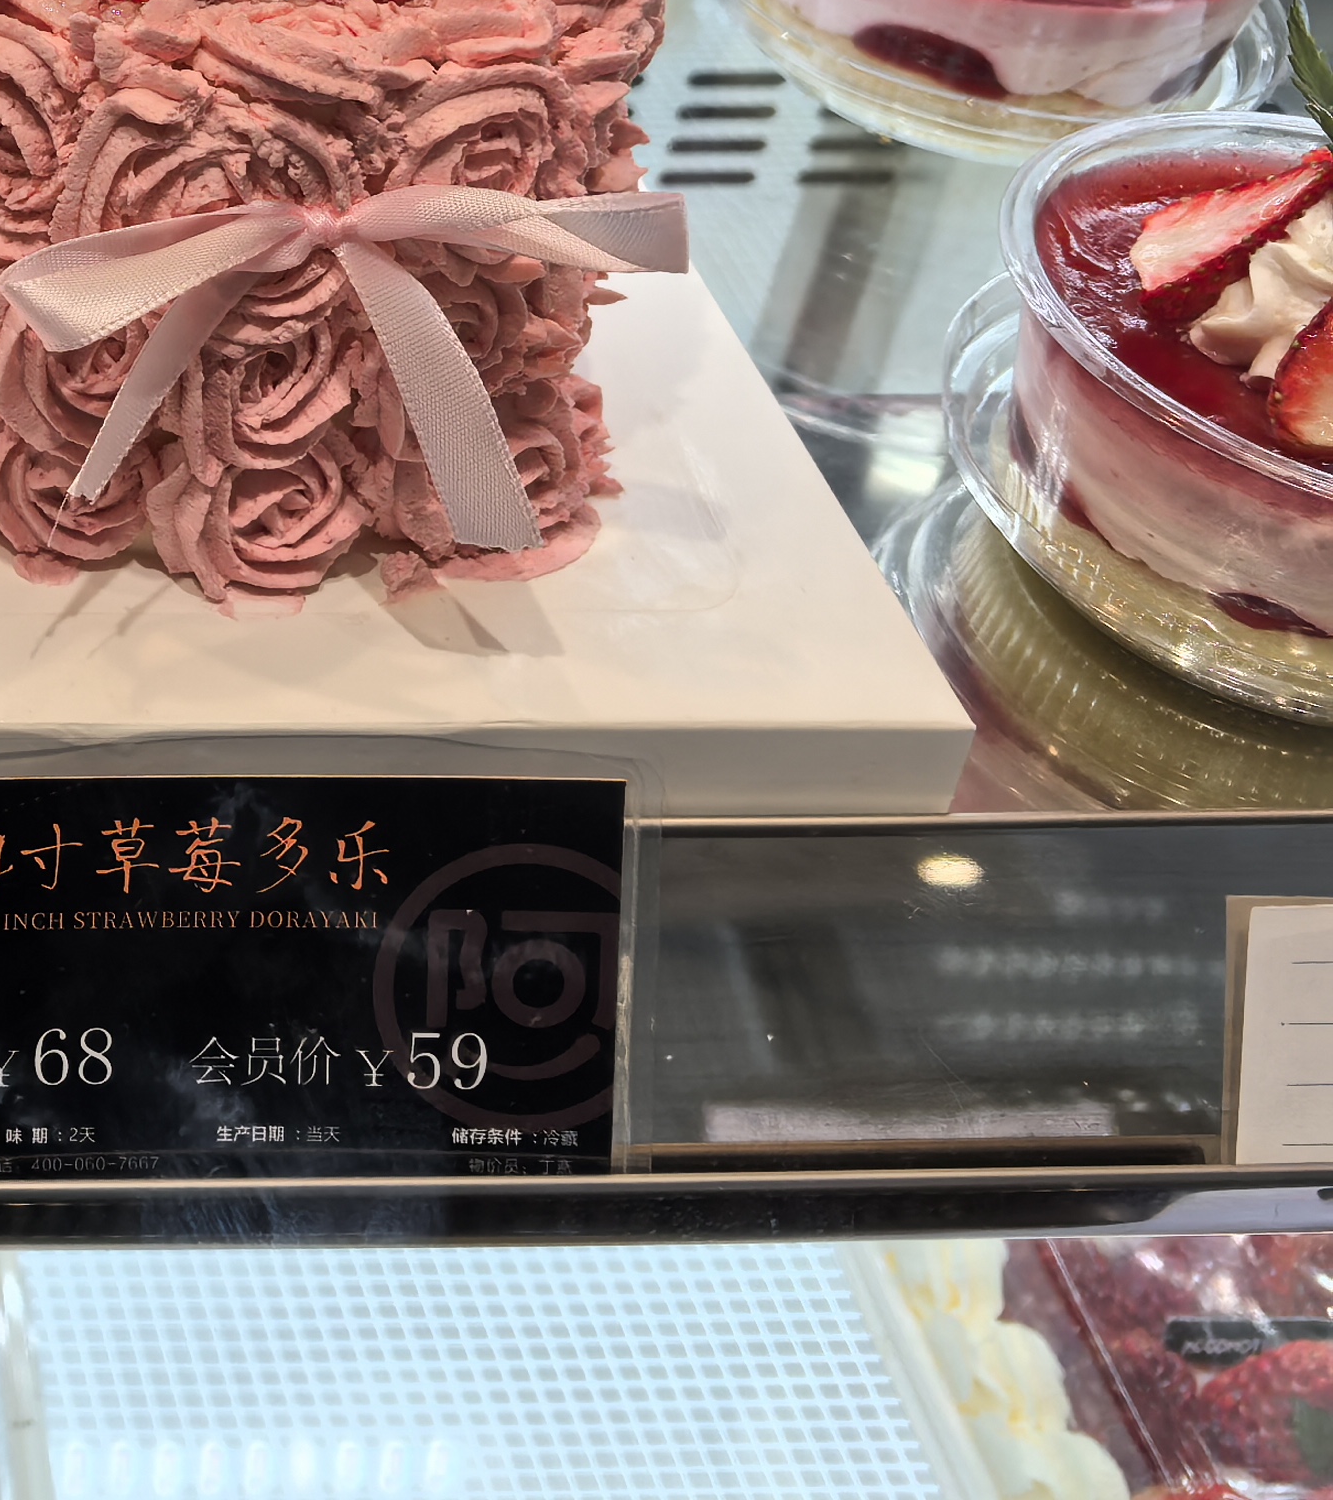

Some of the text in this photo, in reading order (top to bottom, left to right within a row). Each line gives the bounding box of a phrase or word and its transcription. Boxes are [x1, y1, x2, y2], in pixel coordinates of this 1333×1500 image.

[3, 911, 66, 931] INCH
[73, 910, 241, 930] STRAWBERRY
[249, 910, 378, 929] DORAYAKI
